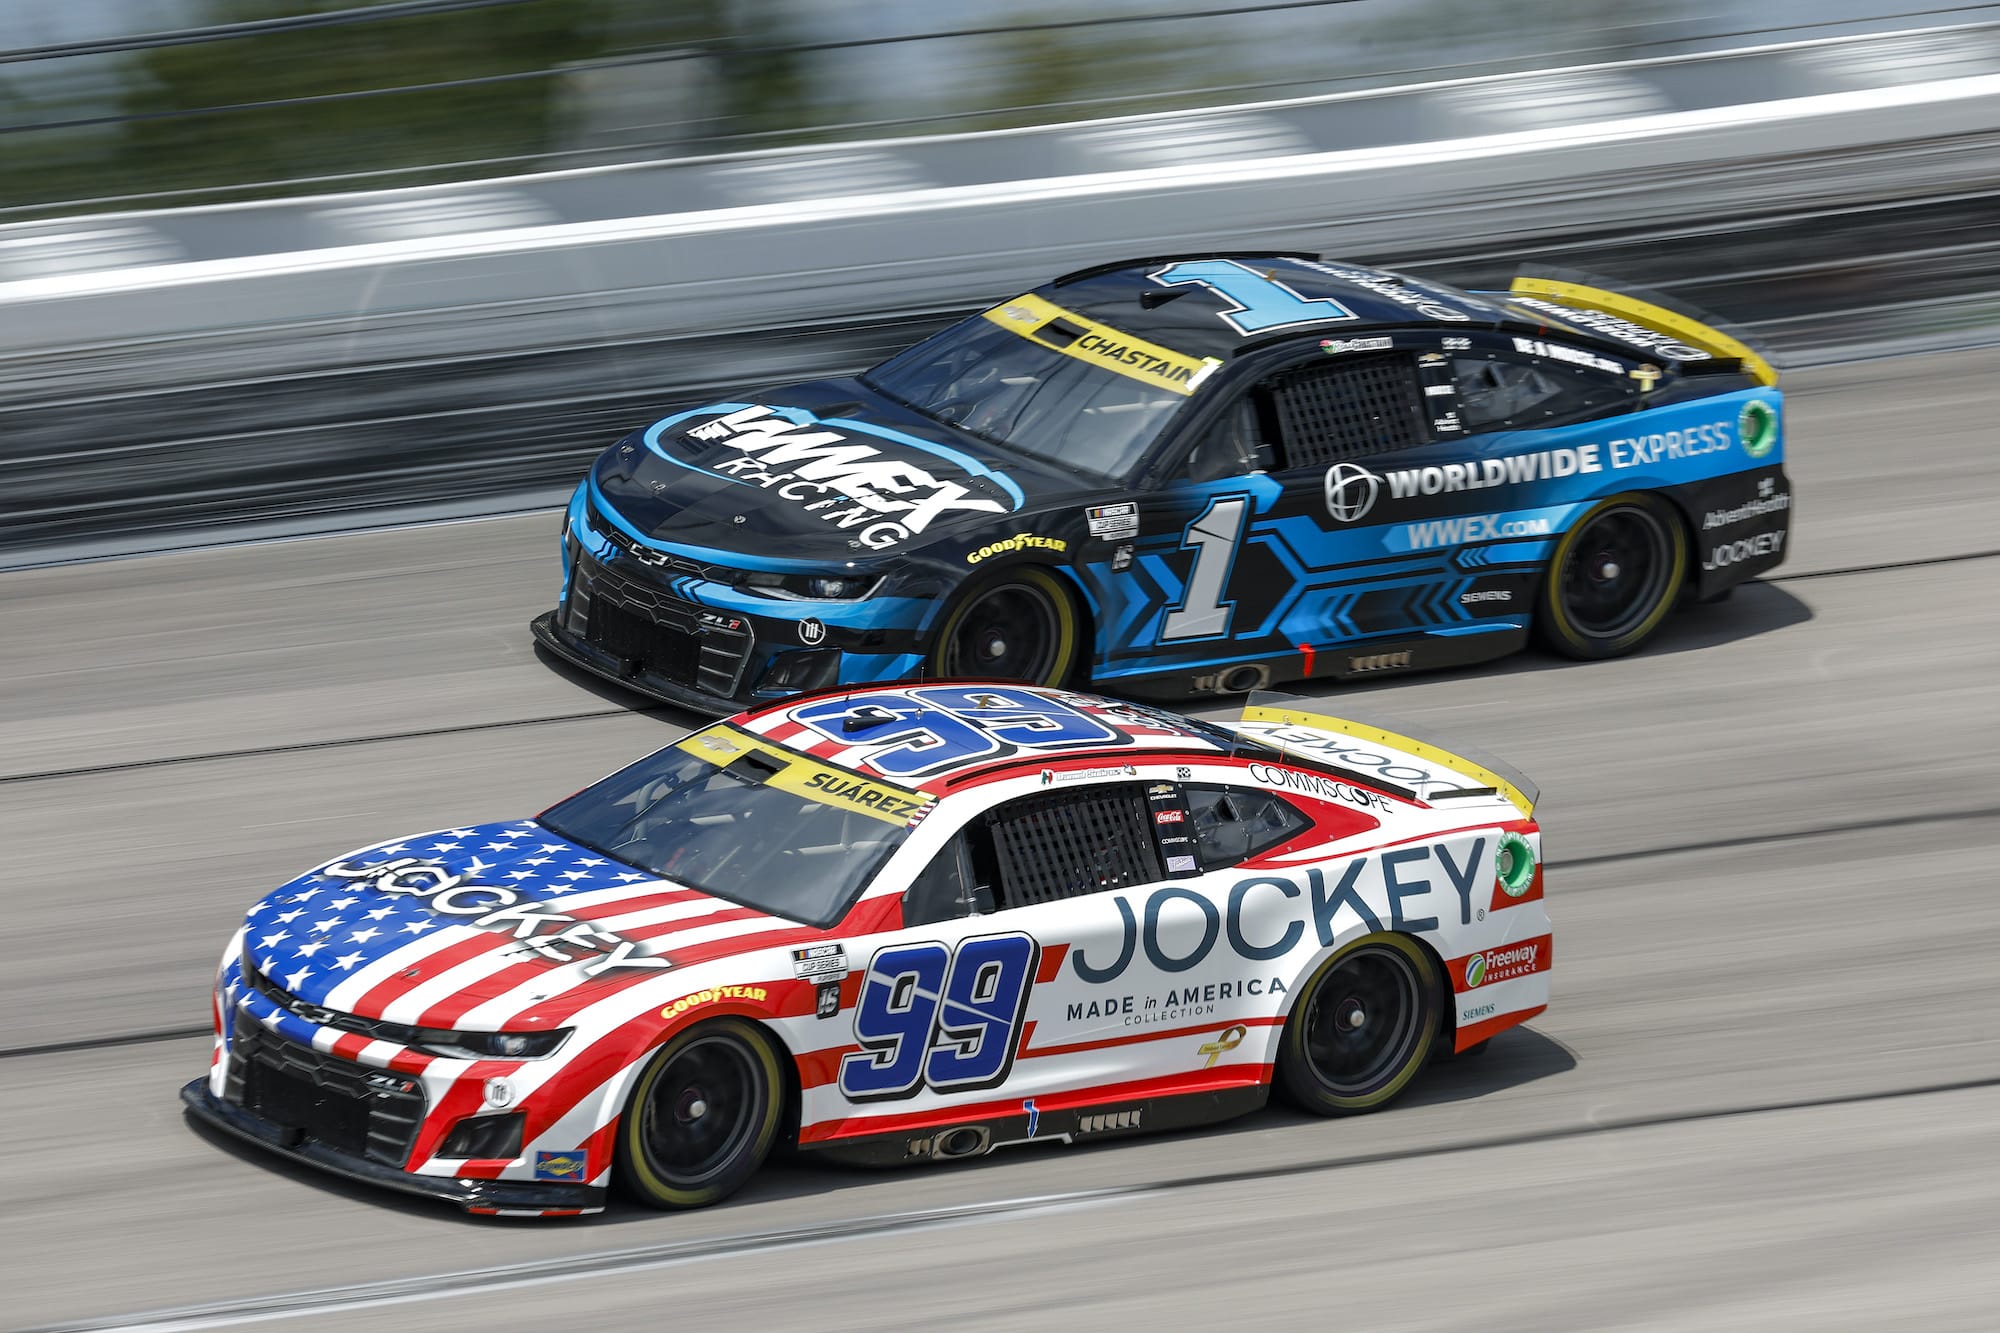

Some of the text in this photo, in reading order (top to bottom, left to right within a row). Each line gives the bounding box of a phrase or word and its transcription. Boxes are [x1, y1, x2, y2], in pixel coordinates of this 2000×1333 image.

[1147, 259, 1359, 337] 1
[1079, 335, 1194, 382] CHASTAIN
[686, 404, 1010, 534] WWEX
[1386, 443, 1603, 499] WORLDWIDE
[1609, 421, 1732, 469] EXPRESS
[713, 457, 910, 550] RACING
[966, 532, 1067, 564] GOODYEAR
[1407, 513, 1550, 550] WWEX.COM
[1702, 530, 1786, 571] JOCKEY
[1155, 493, 1250, 646] 1
[788, 685, 1126, 777] 99
[1240, 725, 1466, 791] JOCKEY
[803, 773, 920, 819] SUÁREZ
[1250, 764, 1394, 814] COMMSCOPE
[324, 857, 673, 978] JOCKEY
[1072, 836, 1487, 985] JOCKEY
[1484, 963, 1537, 983] INSURANCE
[1485, 944, 1538, 971] Freeway
[660, 985, 768, 1020] GOODYEAR
[838, 931, 1042, 1104] 99
[1066, 977, 1288, 1021] MADE in AMERICA
[1124, 1003, 1215, 1027] COLLECTION
[1462, 1003, 1495, 1021] SIEMENS
